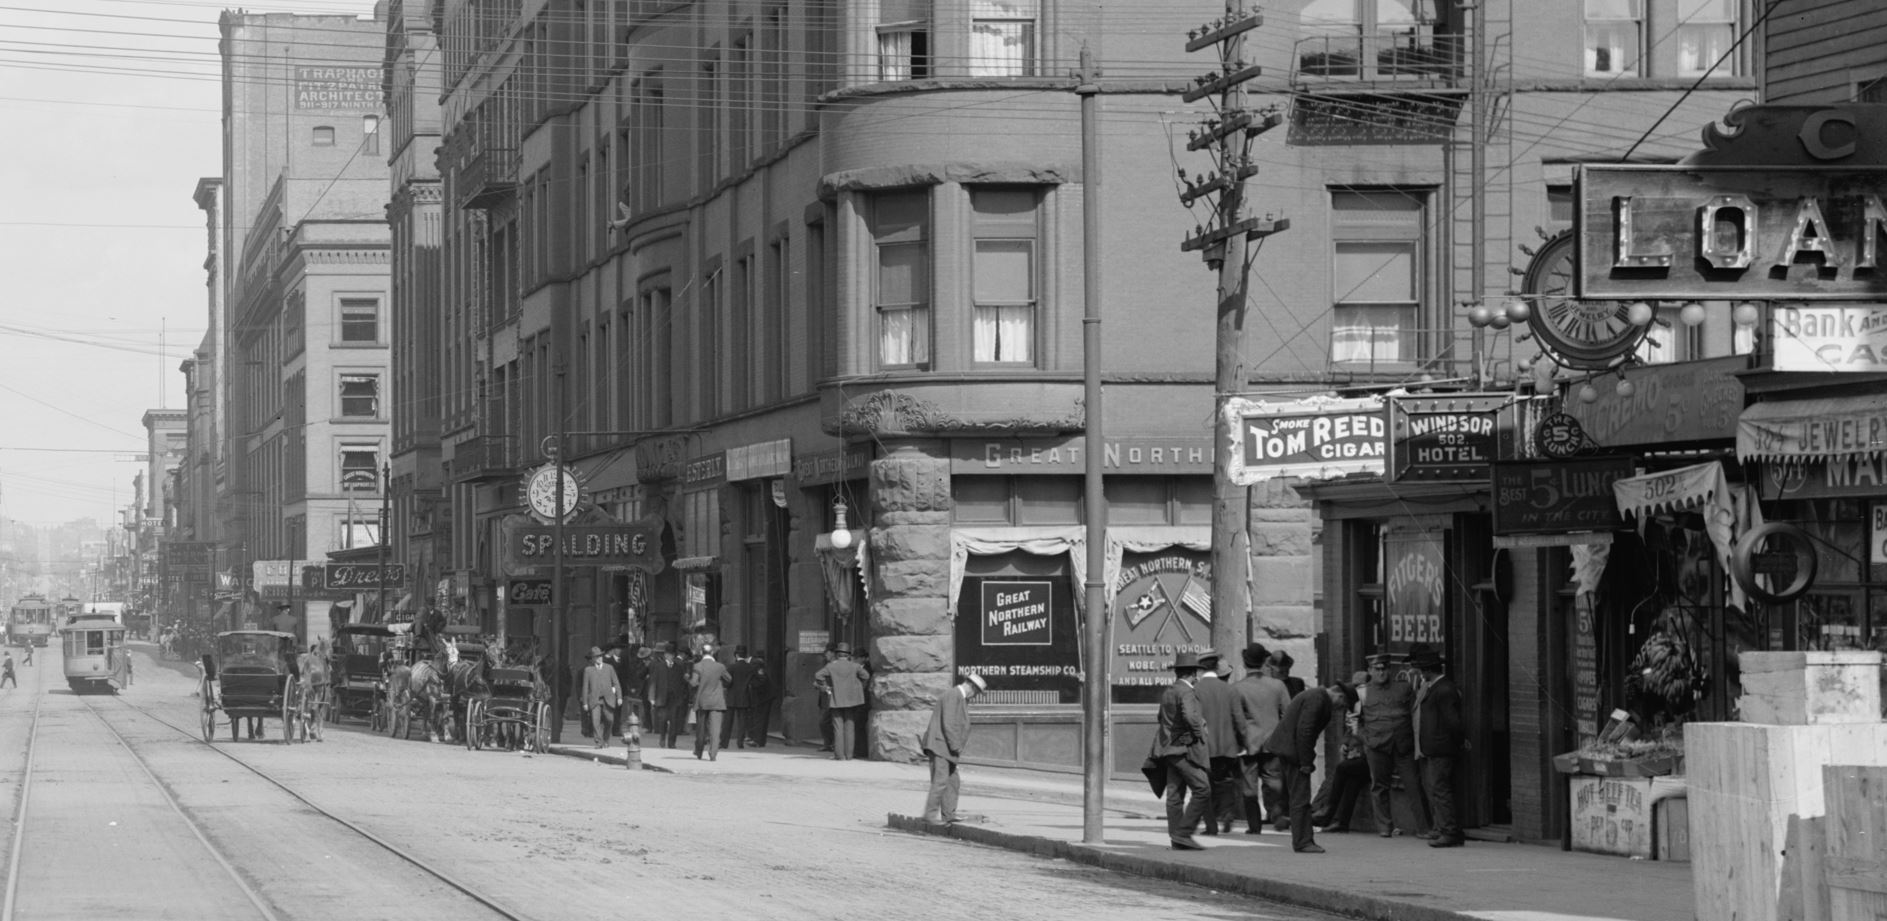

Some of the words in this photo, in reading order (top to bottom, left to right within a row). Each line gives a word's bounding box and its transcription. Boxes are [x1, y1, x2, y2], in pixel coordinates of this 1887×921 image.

[1784, 307, 1855, 338] Bank
[1271, 418, 1310, 435] SMOKE
[1410, 415, 1494, 436] WINDSOR
[1249, 424, 1306, 459] TOM
[1313, 415, 1384, 447] REED
[1543, 436, 1580, 455] LUNCH
[985, 442, 1080, 468] GREAT
[1103, 442, 1214, 468] NORTH
[1503, 476, 1523, 486] THE
[1644, 475, 1676, 501] 502
[1499, 486, 1527, 506] BEST
[1521, 512, 1538, 523] IN
[1546, 510, 1574, 523] THE
[1577, 509, 1610, 523] CITY
[1876, 508, 1887, 530] B
[521, 533, 647, 557] SPALDING
[1139, 556, 1193, 575] NORTHERN
[996, 590, 1031, 607] GREAT
[989, 603, 1045, 627] NORTHERN
[1003, 618, 1047, 636] RAILWAY
[1118, 643, 1156, 655] SEATTLE
[1161, 643, 1171, 655] TO
[958, 665, 1007, 676] NORTHERN
[1009, 665, 1062, 676] STEAMSHIP
[1119, 676, 1136, 685] AND
[1139, 676, 1152, 685] ALL
